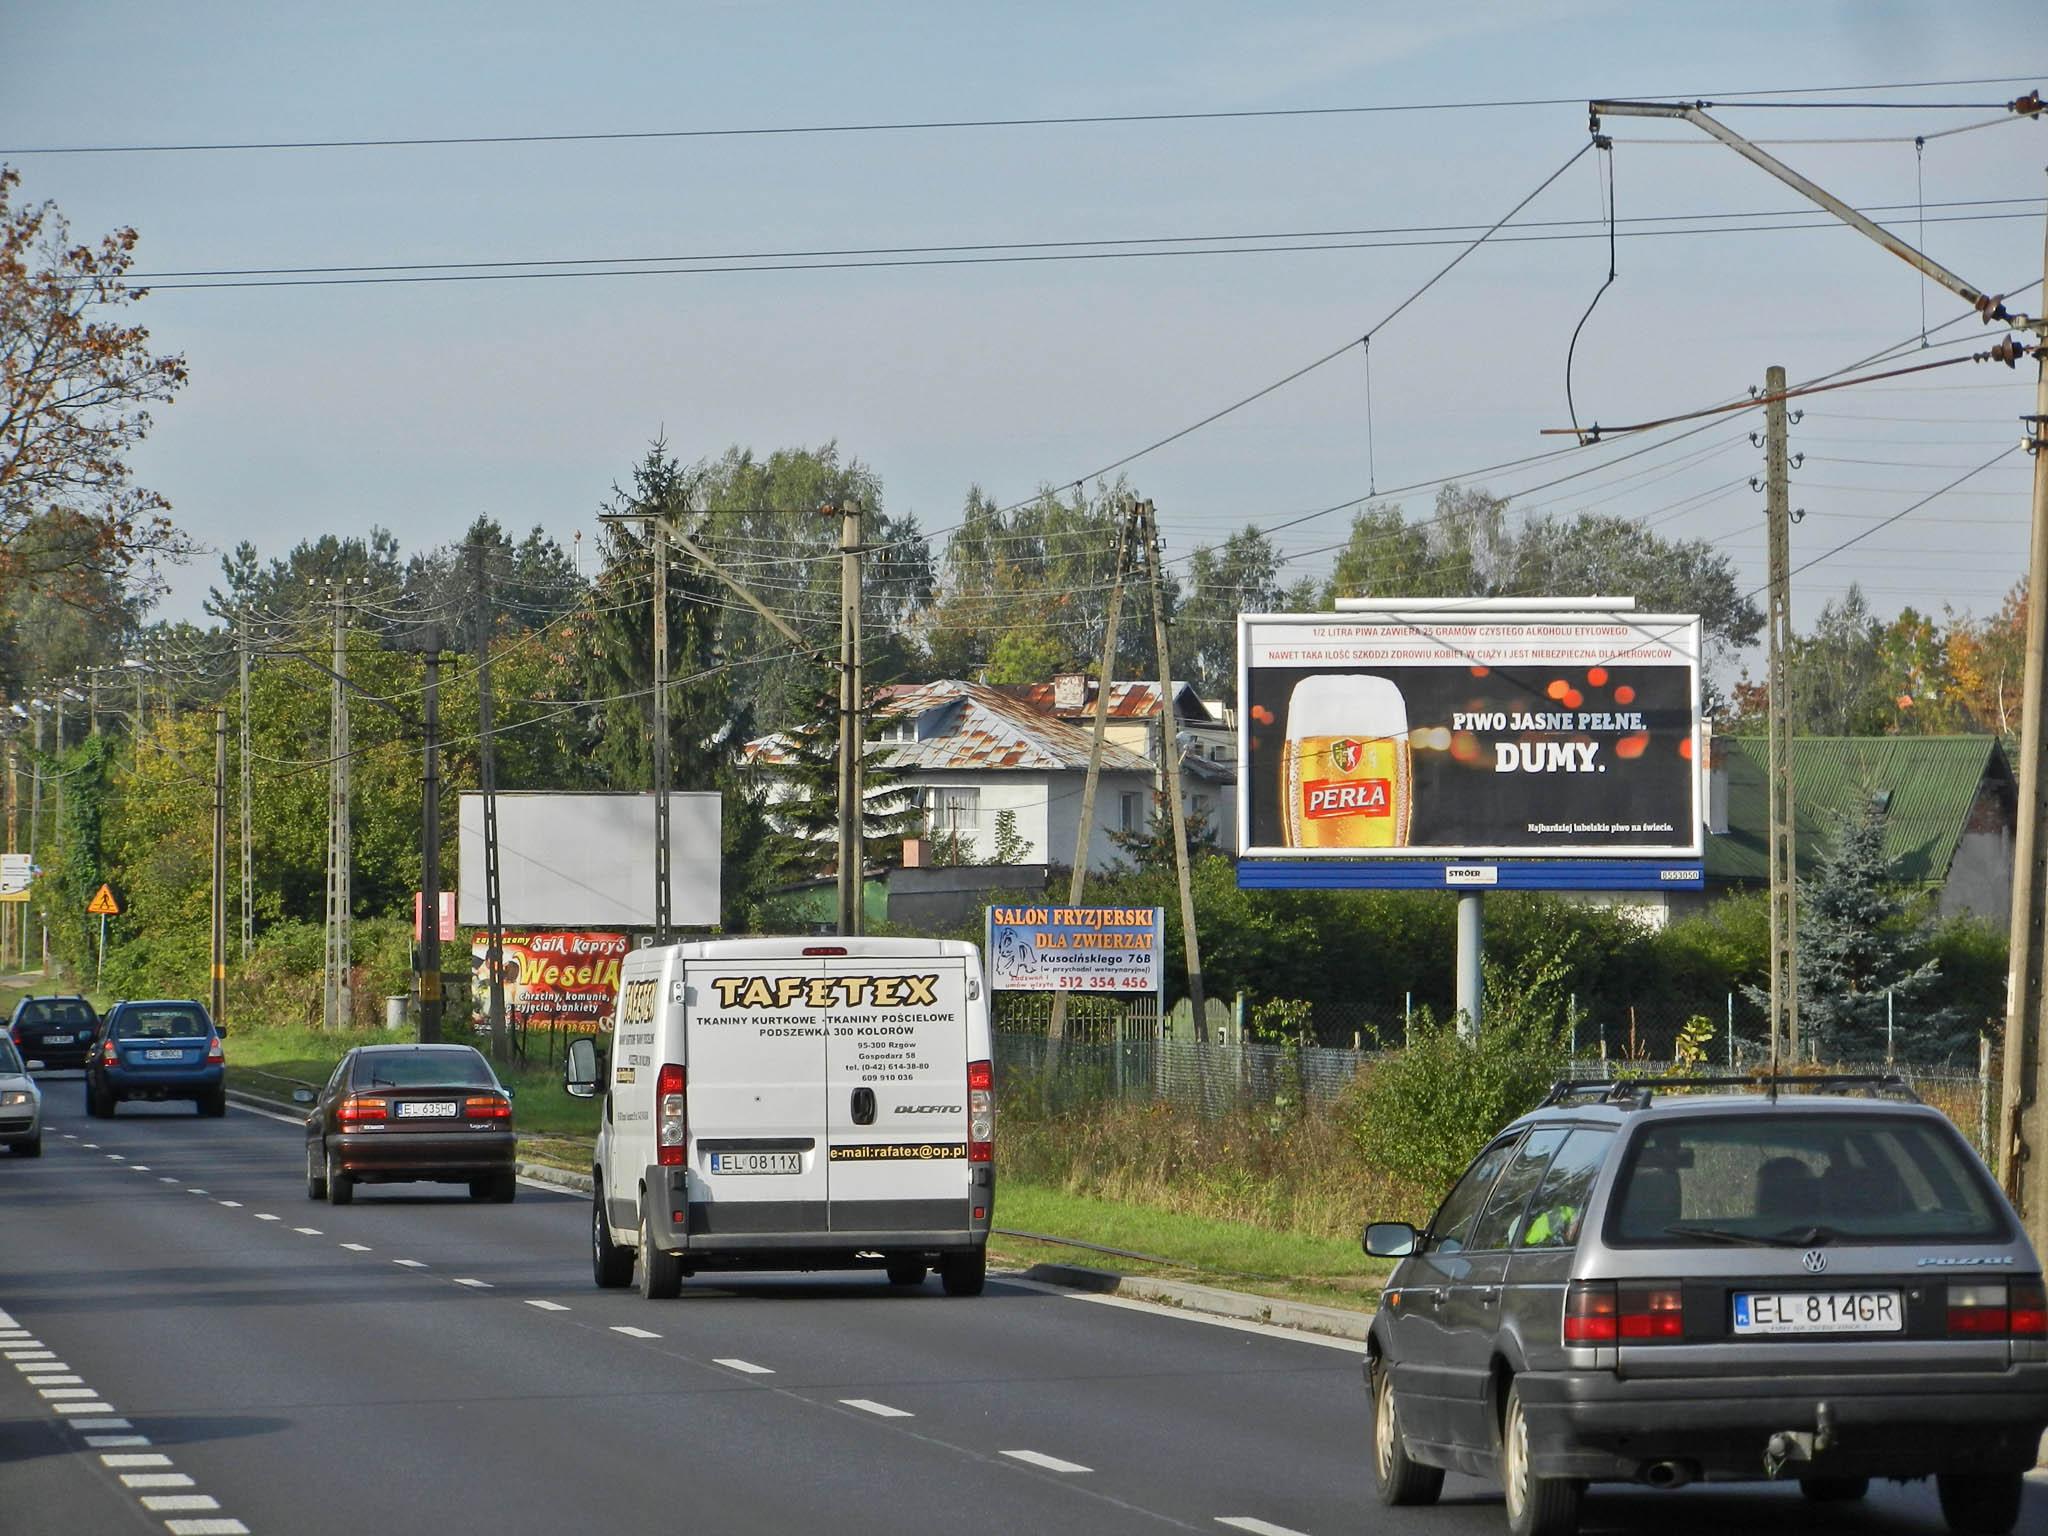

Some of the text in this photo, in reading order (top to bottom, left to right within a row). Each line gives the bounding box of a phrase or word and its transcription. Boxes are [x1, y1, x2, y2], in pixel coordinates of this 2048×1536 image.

[1312, 627, 1326, 637] 1/2
[1328, 628, 1353, 637] LITRA
[1355, 628, 1378, 637] PIWA
[1380, 627, 1420, 636] ZAWIERA
[1435, 625, 1477, 636] GRAMÓW
[1479, 627, 1524, 636] CZYSTEGO
[1526, 627, 1572, 636] ALKOHOLU
[1574, 627, 1628, 636] ETYLOWEGO
[1268, 650, 1299, 660] NAWET
[1302, 650, 1323, 660] TAKA
[1325, 647, 1350, 660] ILOŚĆ
[1353, 650, 1389, 659] SZKODZI
[1390, 650, 1432, 659] ZDROWIU
[1434, 650, 1465, 659] KOBIET
[1466, 650, 1475, 659] W
[1508, 650, 1529, 658] JEST
[1531, 650, 1597, 659] NIEBEZPIECZNA
[1600, 650, 1614, 658] DLA
[1617, 648, 1672, 658] KIEROWCÓW
[1453, 712, 1647, 731] PIWO JASNE PEŁNE.
[1495, 742, 1606, 773] DUMY.
[1309, 786, 1386, 812] PERŁA
[1528, 823, 1573, 834] Najbardziej
[1573, 823, 1609, 832] lubelskie
[1611, 823, 1630, 833] piwo
[994, 908, 1153, 929] SALON FRYZJERSKI
[1035, 933, 1070, 949] DLA
[1040, 953, 1151, 965] Kusocińskiego 76B
[1052, 966, 1092, 974] przychodni
[1059, 976, 1148, 989] 512 354 456
[519, 992, 610, 1002] chrzciny, komunie,
[711, 974, 939, 1009] TAFETEX
[556, 1002, 599, 1013] bankiety
[697, 1016, 748, 1025] TKANINY
[752, 1016, 817, 1025] KURTKOWE
[882, 1012, 955, 1022] POŚCIELOWE
[759, 1028, 831, 1037] PODSZEWKA
[834, 1028, 854, 1036] 300
[858, 1053, 903, 1061] Gospodarz
[861, 1063, 886, 1071] (0-42)
[404, 1103, 418, 1114] EL
[721, 1155, 797, 1170] EL 0811X
[1754, 1294, 1893, 1324] EL 814GR
